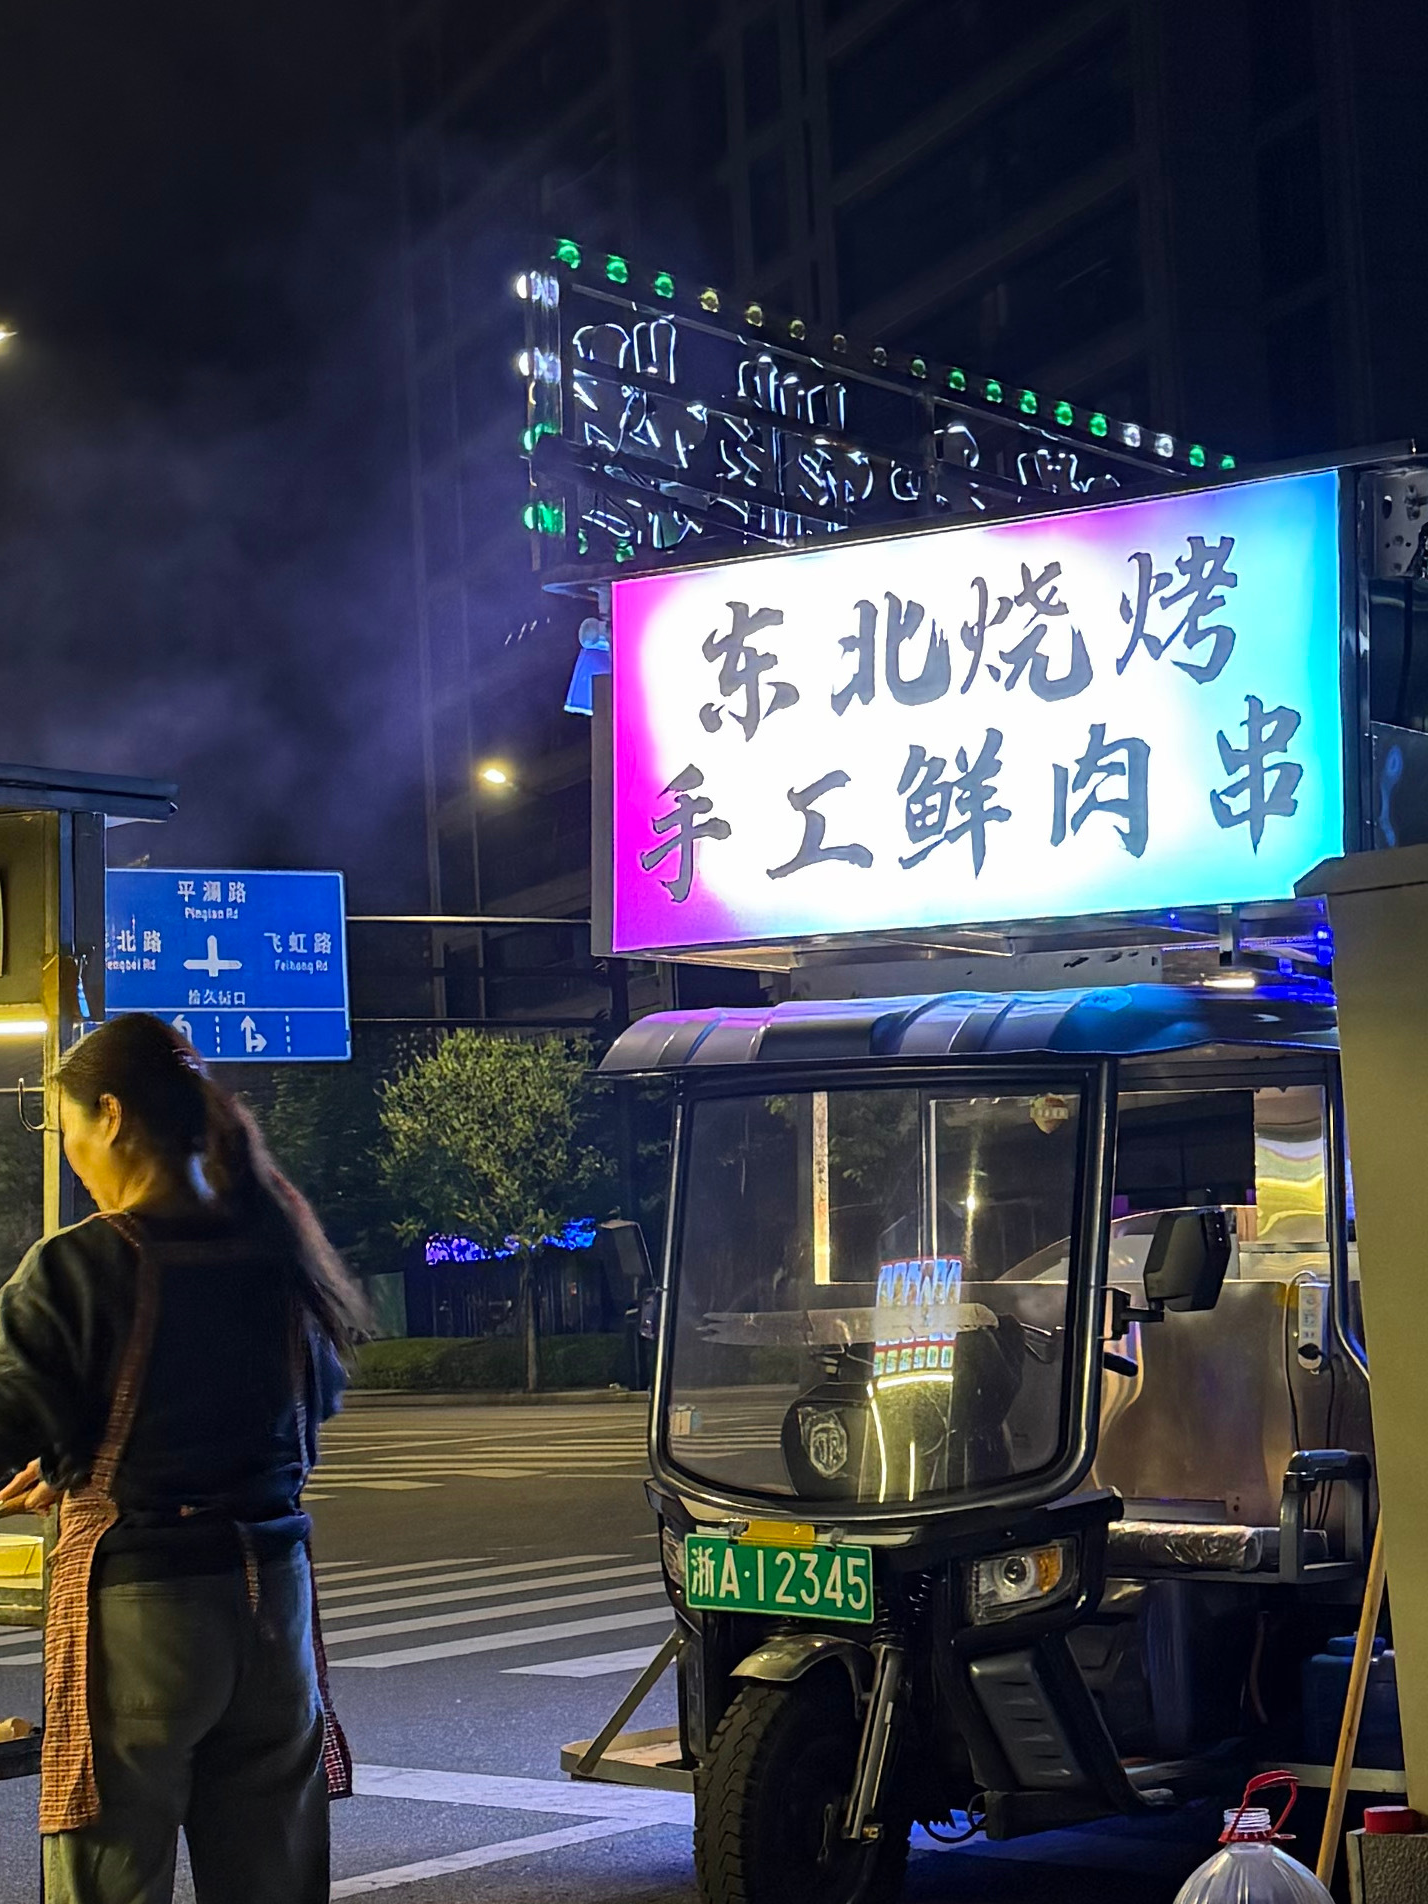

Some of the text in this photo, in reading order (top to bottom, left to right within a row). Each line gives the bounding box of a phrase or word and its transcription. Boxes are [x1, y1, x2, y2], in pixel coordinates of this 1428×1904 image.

[698, 535, 1239, 743] 东北烧烤
[640, 694, 1304, 904] 手工鲜肉串
[177, 880, 246, 904] 平澜路
[105, 929, 162, 953] 北路
[263, 931, 332, 955] 飞虹路
[105, 958, 141, 973] engbei
